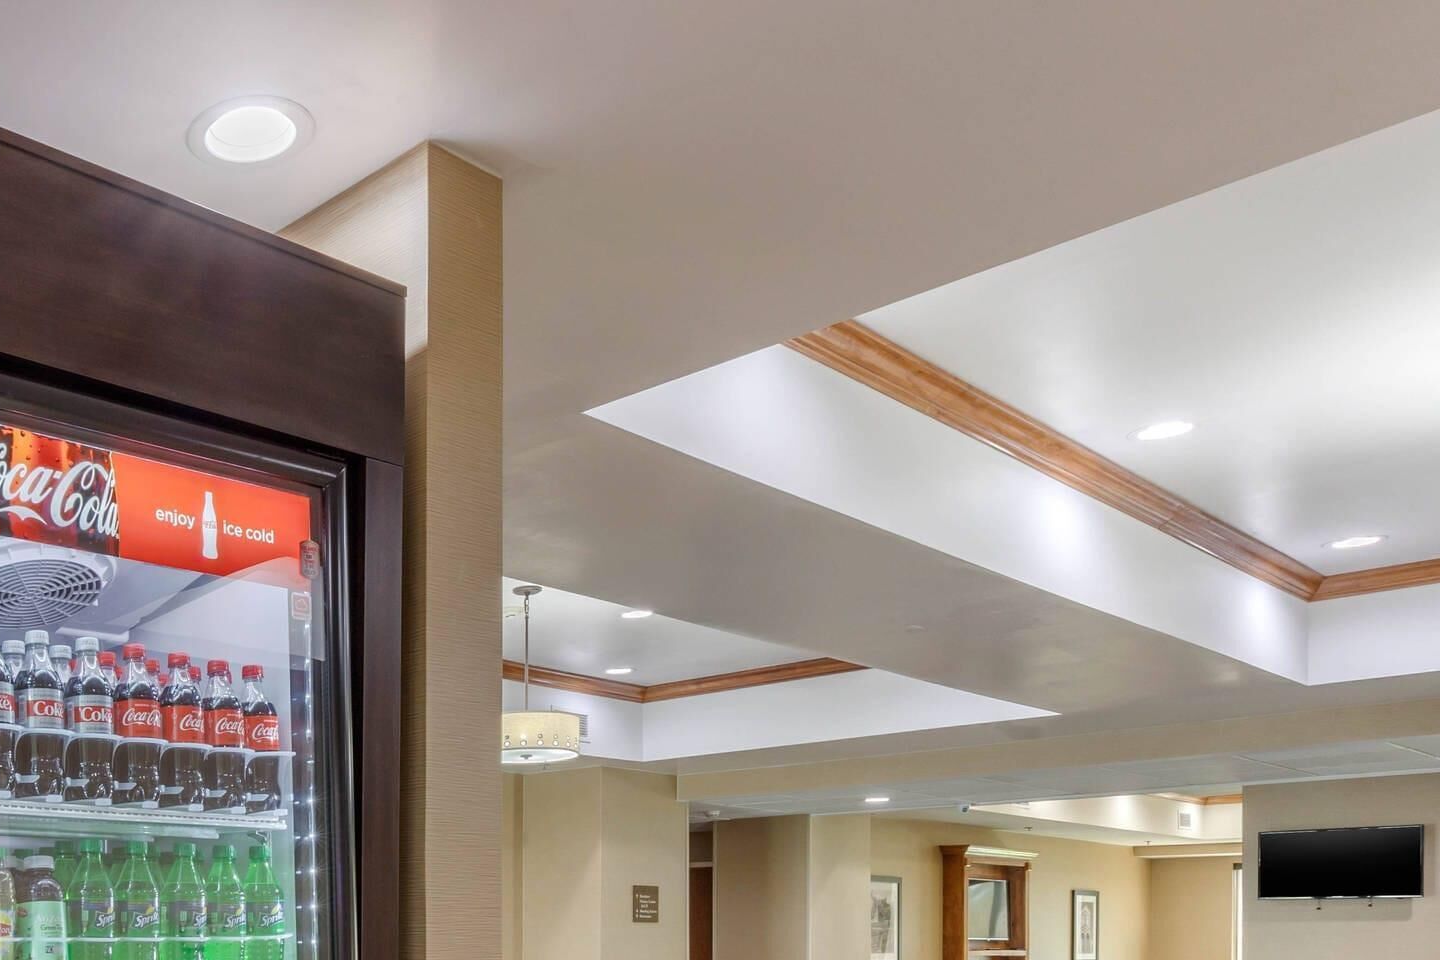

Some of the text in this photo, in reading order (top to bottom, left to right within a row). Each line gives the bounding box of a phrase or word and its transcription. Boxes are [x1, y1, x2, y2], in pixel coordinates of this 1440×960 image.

[155, 507, 196, 530] enjoy
[223, 517, 242, 538] ice
[245, 525, 275, 544] cold
